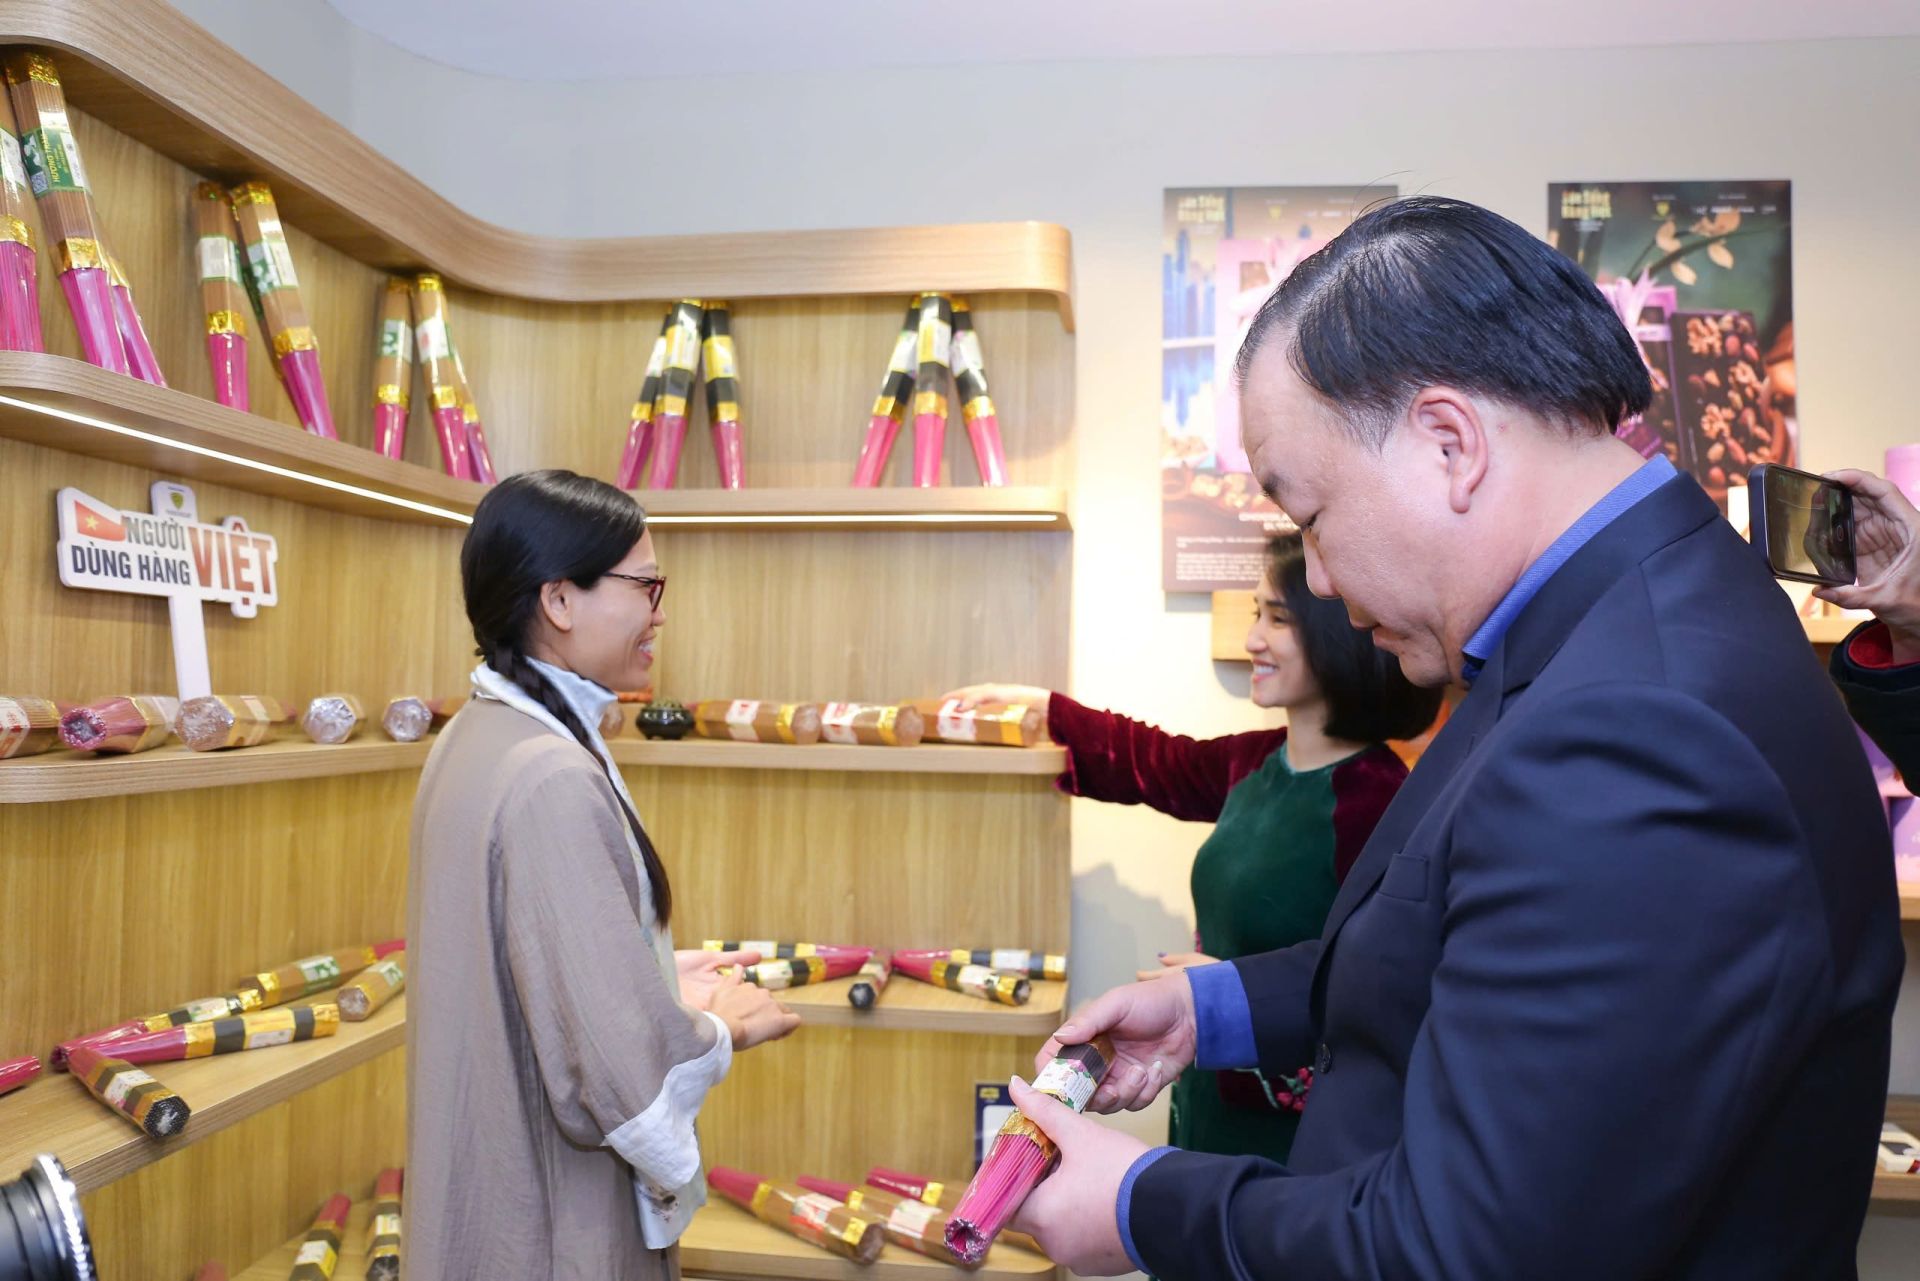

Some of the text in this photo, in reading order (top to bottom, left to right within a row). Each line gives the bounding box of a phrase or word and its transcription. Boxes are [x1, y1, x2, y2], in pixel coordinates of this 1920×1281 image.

[124, 515, 187, 551] NGƯỜI
[71, 541, 191, 585] DÙNG HÀNG
[188, 521, 271, 605] VIỆT
